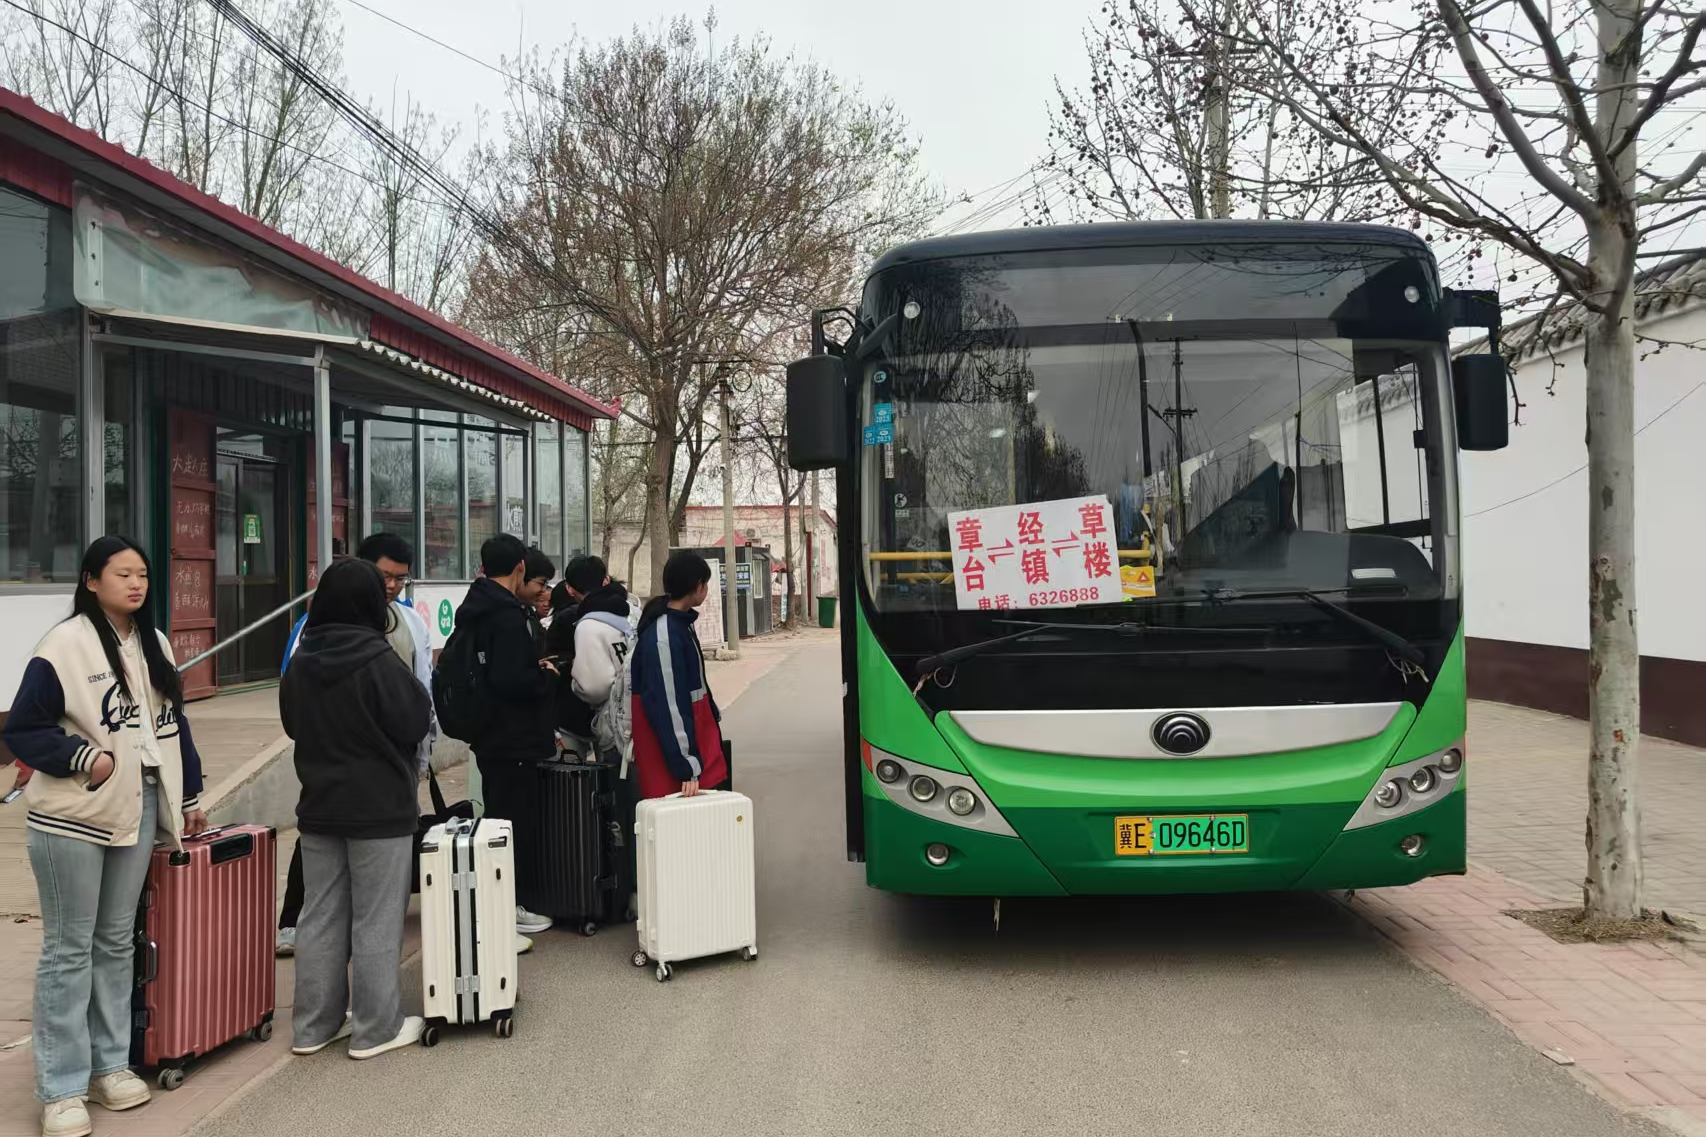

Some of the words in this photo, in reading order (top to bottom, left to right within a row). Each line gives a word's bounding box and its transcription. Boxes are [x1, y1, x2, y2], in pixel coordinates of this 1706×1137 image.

[956, 517, 985, 592] 章台
[1017, 511, 1049, 585] 经镇
[1078, 503, 1112, 578] 草楼
[87, 671, 108, 684] SINCE
[1119, 822, 1147, 849] 冀E
[1158, 819, 1245, 849] 09646D
